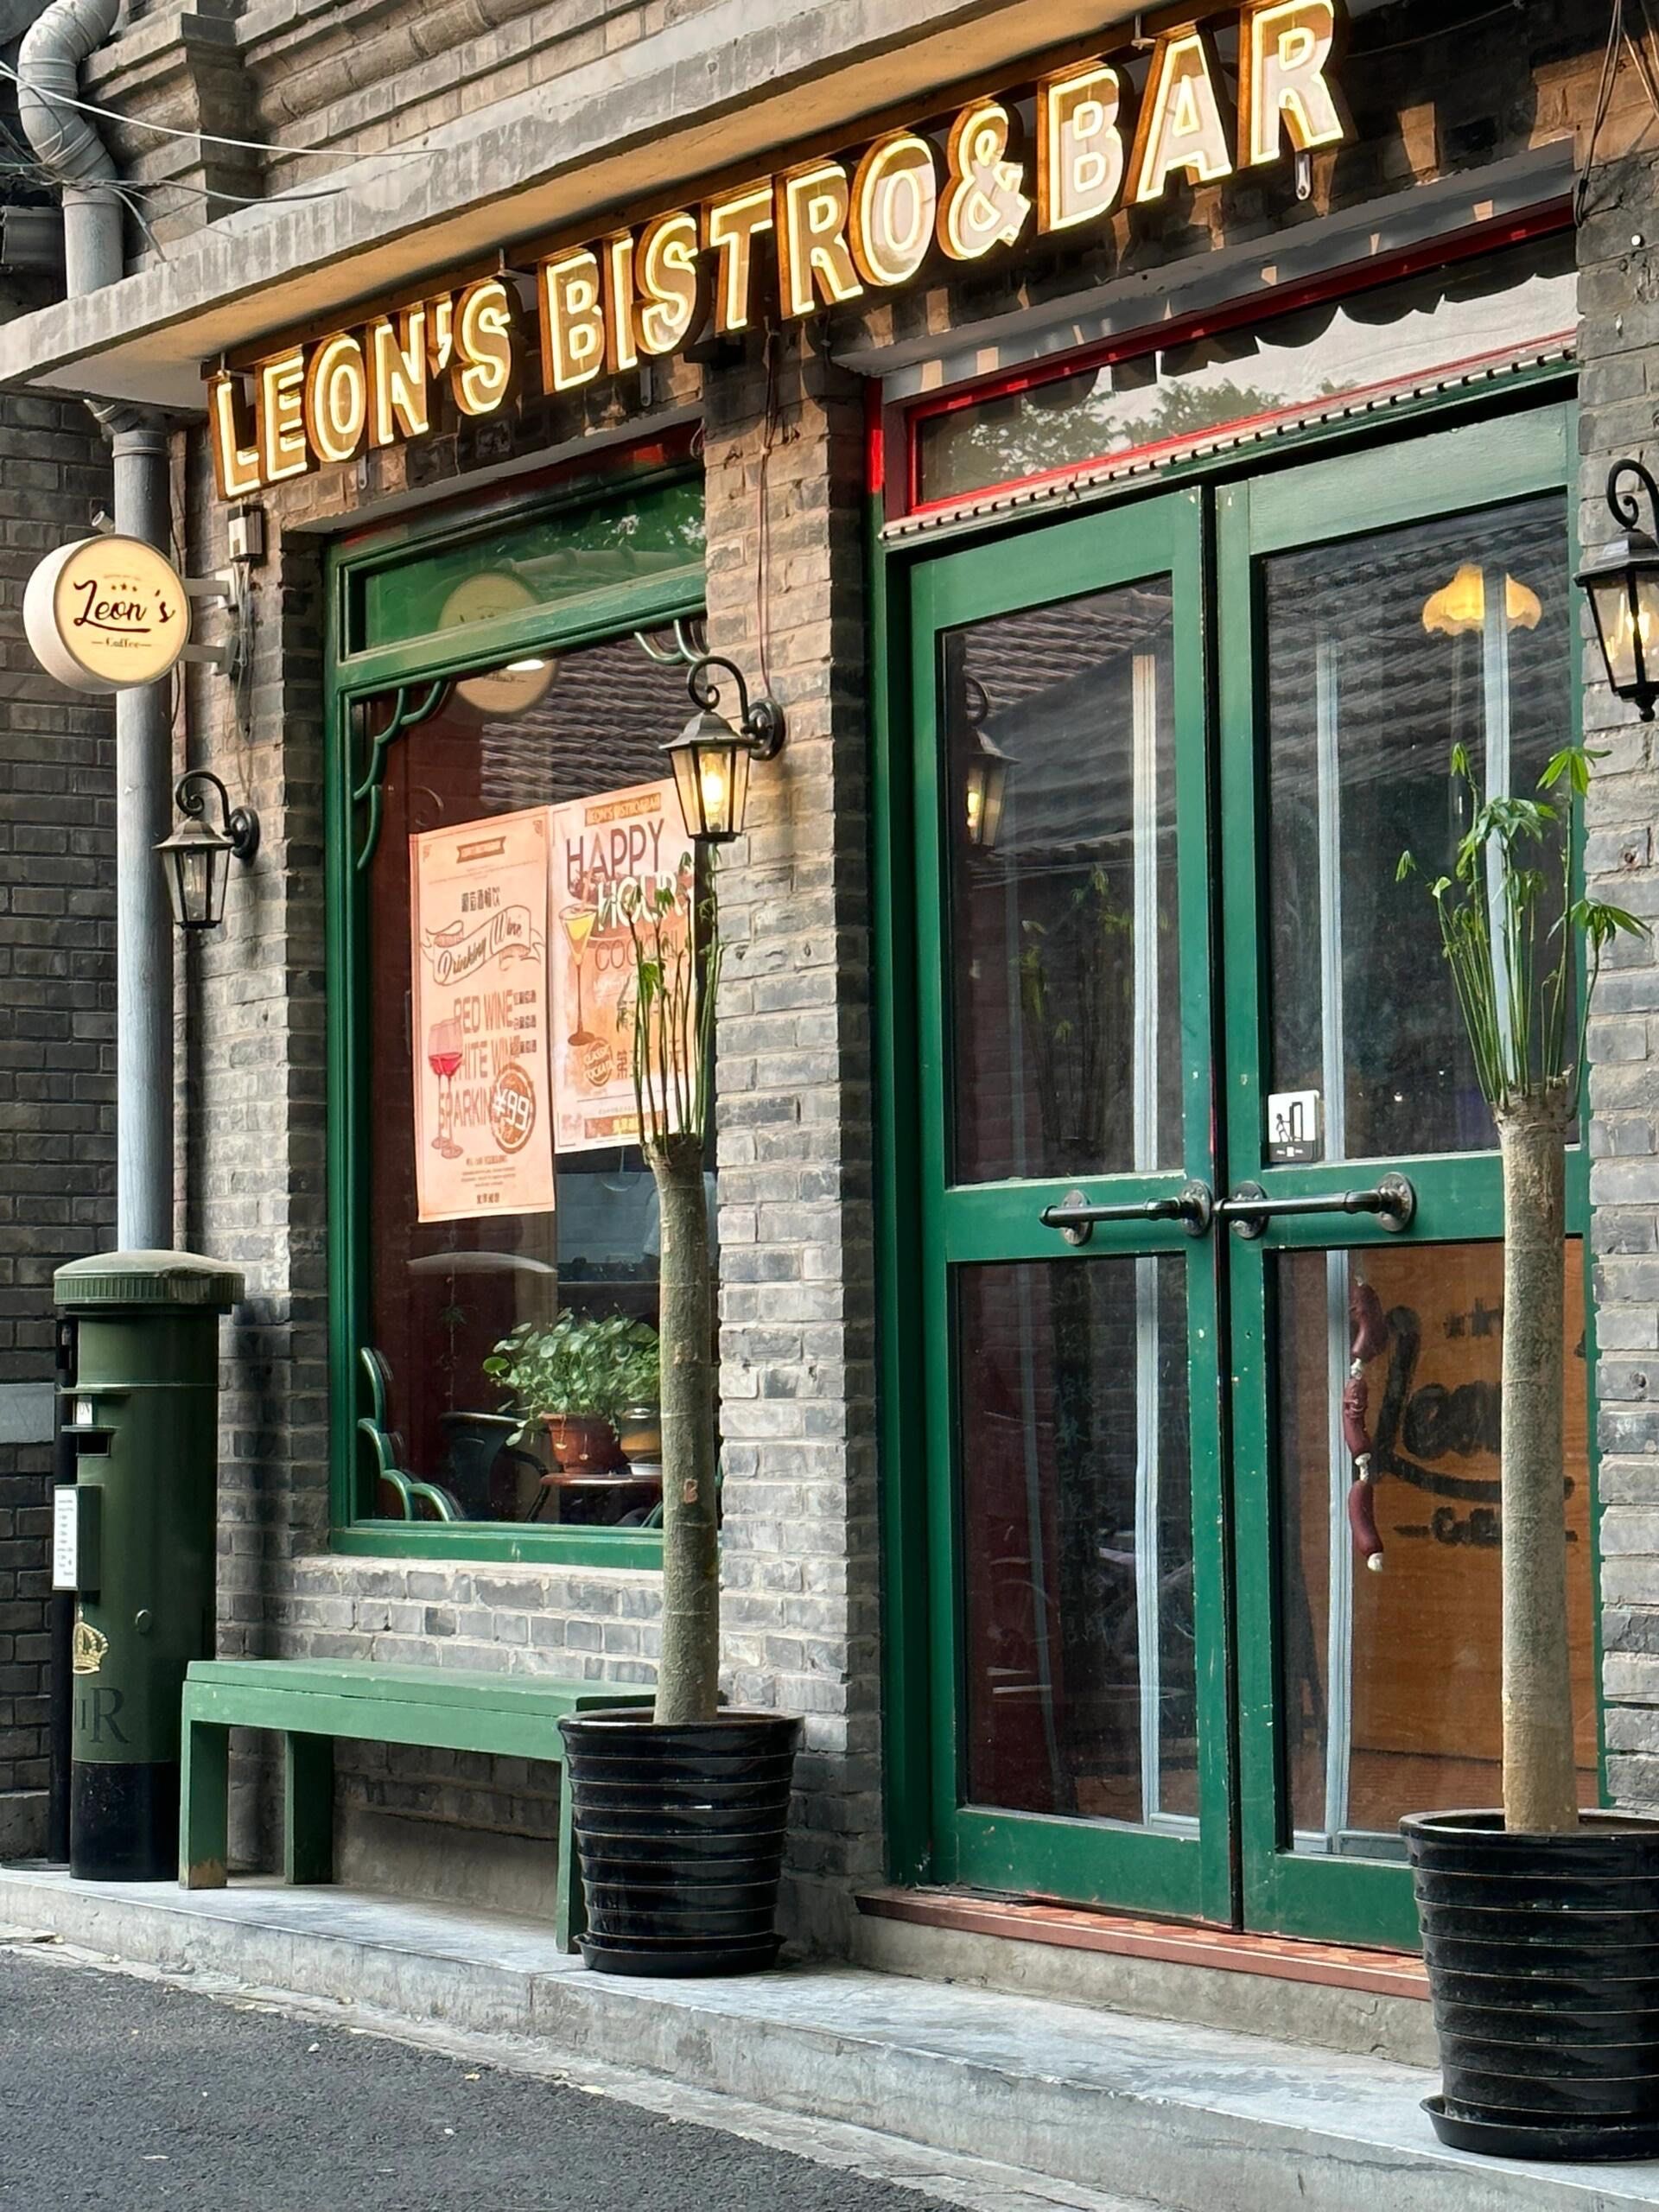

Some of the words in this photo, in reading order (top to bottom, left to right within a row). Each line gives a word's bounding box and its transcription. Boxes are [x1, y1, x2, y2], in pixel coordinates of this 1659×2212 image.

[210, 279, 512, 500] LEON'S
[73, 579, 176, 633] Leon's
[566, 817, 664, 890] HAPPY
[597, 870, 683, 931] HOUR
[453, 995, 481, 1034] RED
[483, 989, 513, 1032] WINE
[453, 1039, 488, 1081] HITE
